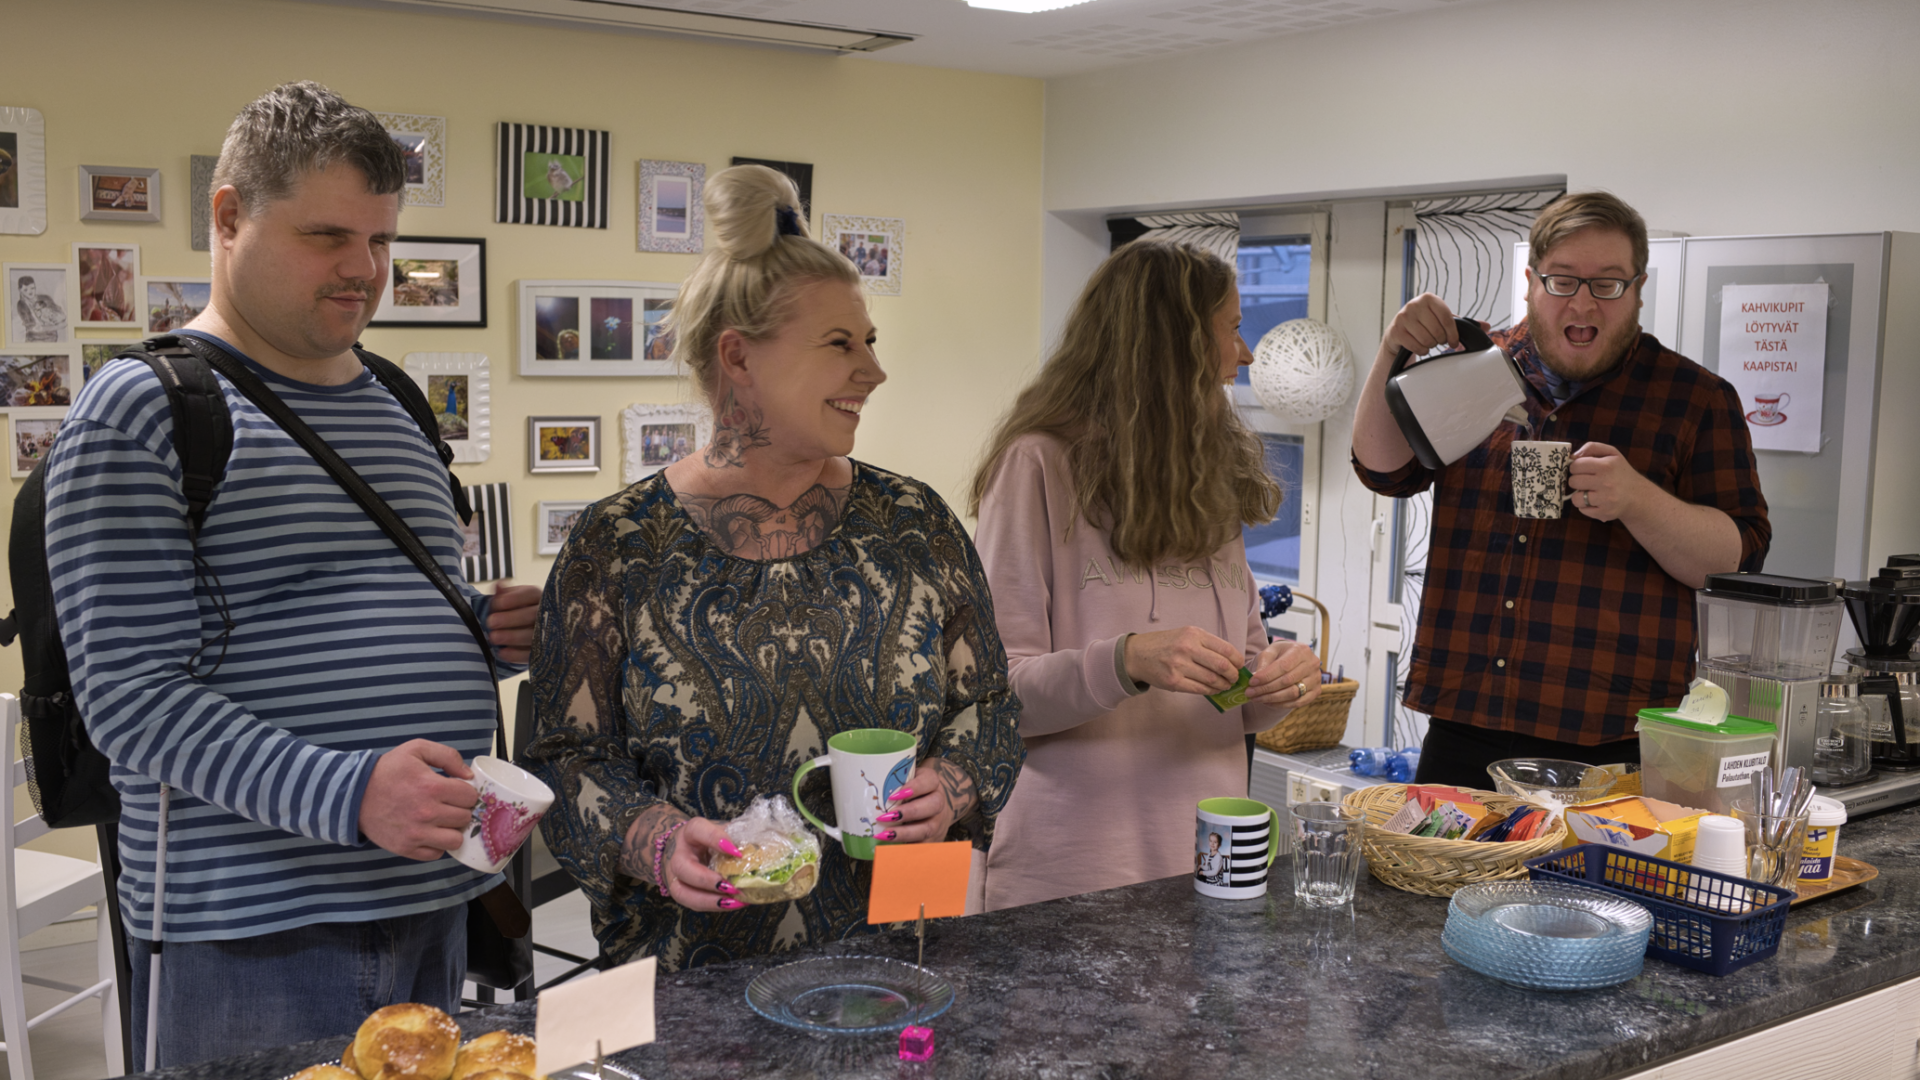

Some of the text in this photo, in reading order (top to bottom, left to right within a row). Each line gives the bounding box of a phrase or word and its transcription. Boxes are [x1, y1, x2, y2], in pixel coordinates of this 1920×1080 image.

[1741, 302, 1805, 313] KAHVIKUPIT
[1745, 320, 1799, 333] LÖYTYVÄT
[1754, 339, 1788, 352] TÄSTÄ
[1743, 361, 1798, 372] KAAPISTA!
